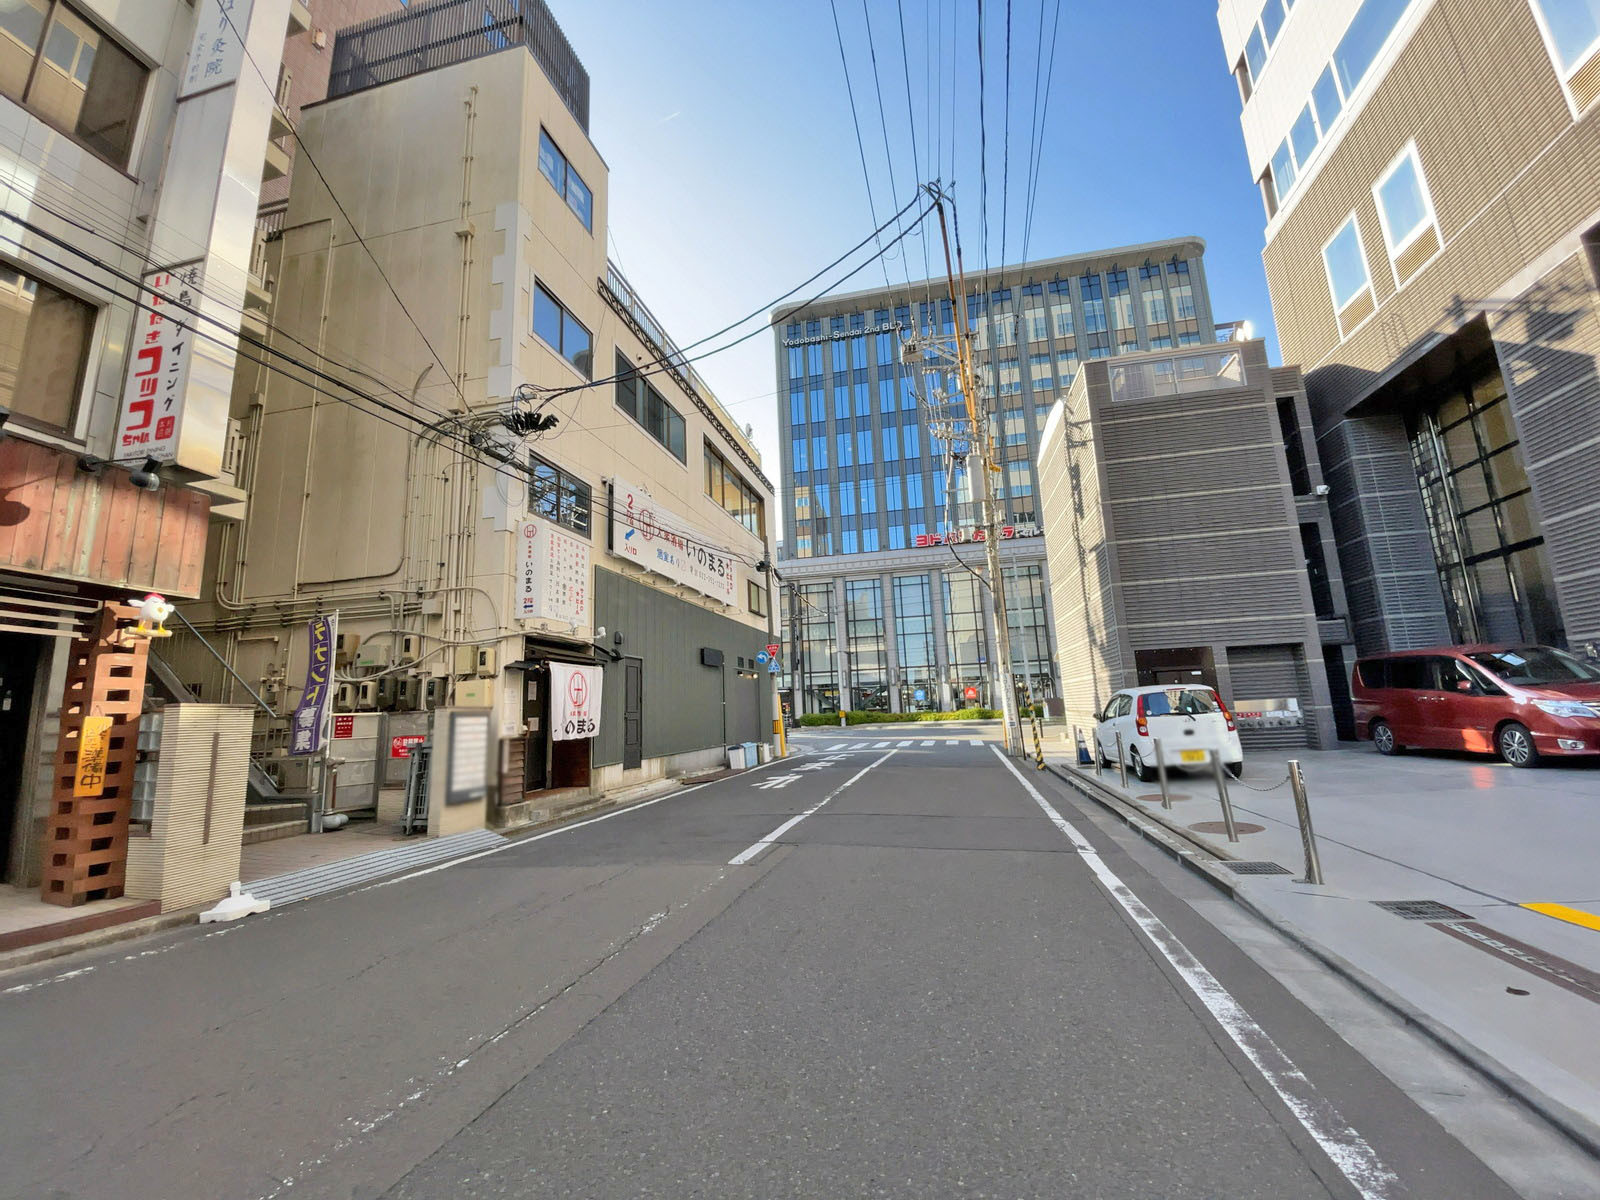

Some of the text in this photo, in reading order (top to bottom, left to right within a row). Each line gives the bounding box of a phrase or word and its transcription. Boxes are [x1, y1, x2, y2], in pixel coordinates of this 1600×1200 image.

[782, 327, 862, 347] Yodobashi-Sendai
[864, 324, 880, 334] 2nd
[686, 538, 725, 577] いのまる
[525, 561, 533, 593] いのまる
